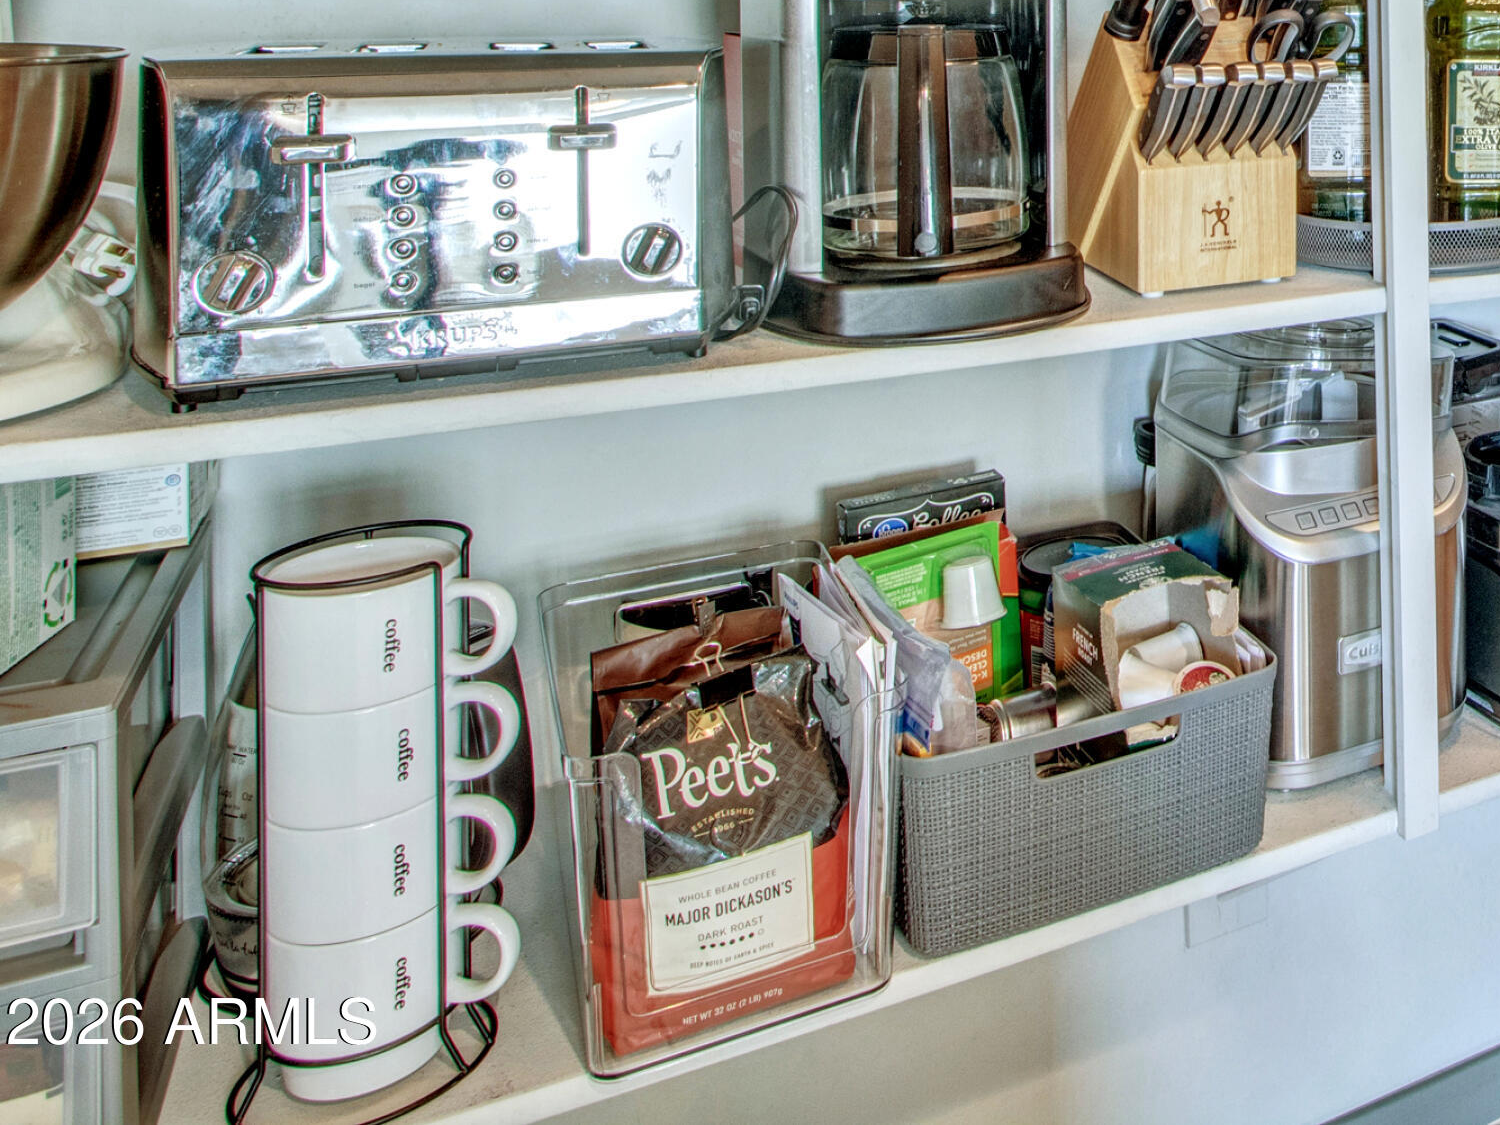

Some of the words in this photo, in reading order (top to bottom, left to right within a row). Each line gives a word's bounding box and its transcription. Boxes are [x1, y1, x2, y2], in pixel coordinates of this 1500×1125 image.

[1455, 135, 1491, 144] EXTRA
[1475, 143, 1497, 151] OLIVE
[412, 323, 499, 351] KRUPS
[384, 617, 397, 674] coffee
[1072, 627, 1098, 661] FRENCH
[397, 727, 410, 783] coffee
[691, 806, 756, 833] ESTABLISHED
[713, 821, 736, 834] 1966
[393, 843, 406, 898] coffee
[678, 887, 713, 904] WHOLE
[714, 880, 740, 895] BEAN
[742, 868, 777, 886] COFFEE
[665, 905, 711, 927] MAJOR
[715, 879, 794, 918] DICKASON'S
[697, 927, 728, 943] DARK
[730, 915, 765, 933] ROAST
[690, 960, 704, 970] DEEP
[705, 957, 724, 967] NOTES
[733, 950, 751, 961] EARTH
[758, 941, 775, 953] SPICE
[395, 956, 408, 1012] coffee
[682, 1014, 698, 1026] NET
[700, 1010, 713, 1022] WT
[714, 1005, 725, 1018] 32
[726, 1001, 737, 1012] OZ
[763, 986, 783, 1001] 907g
